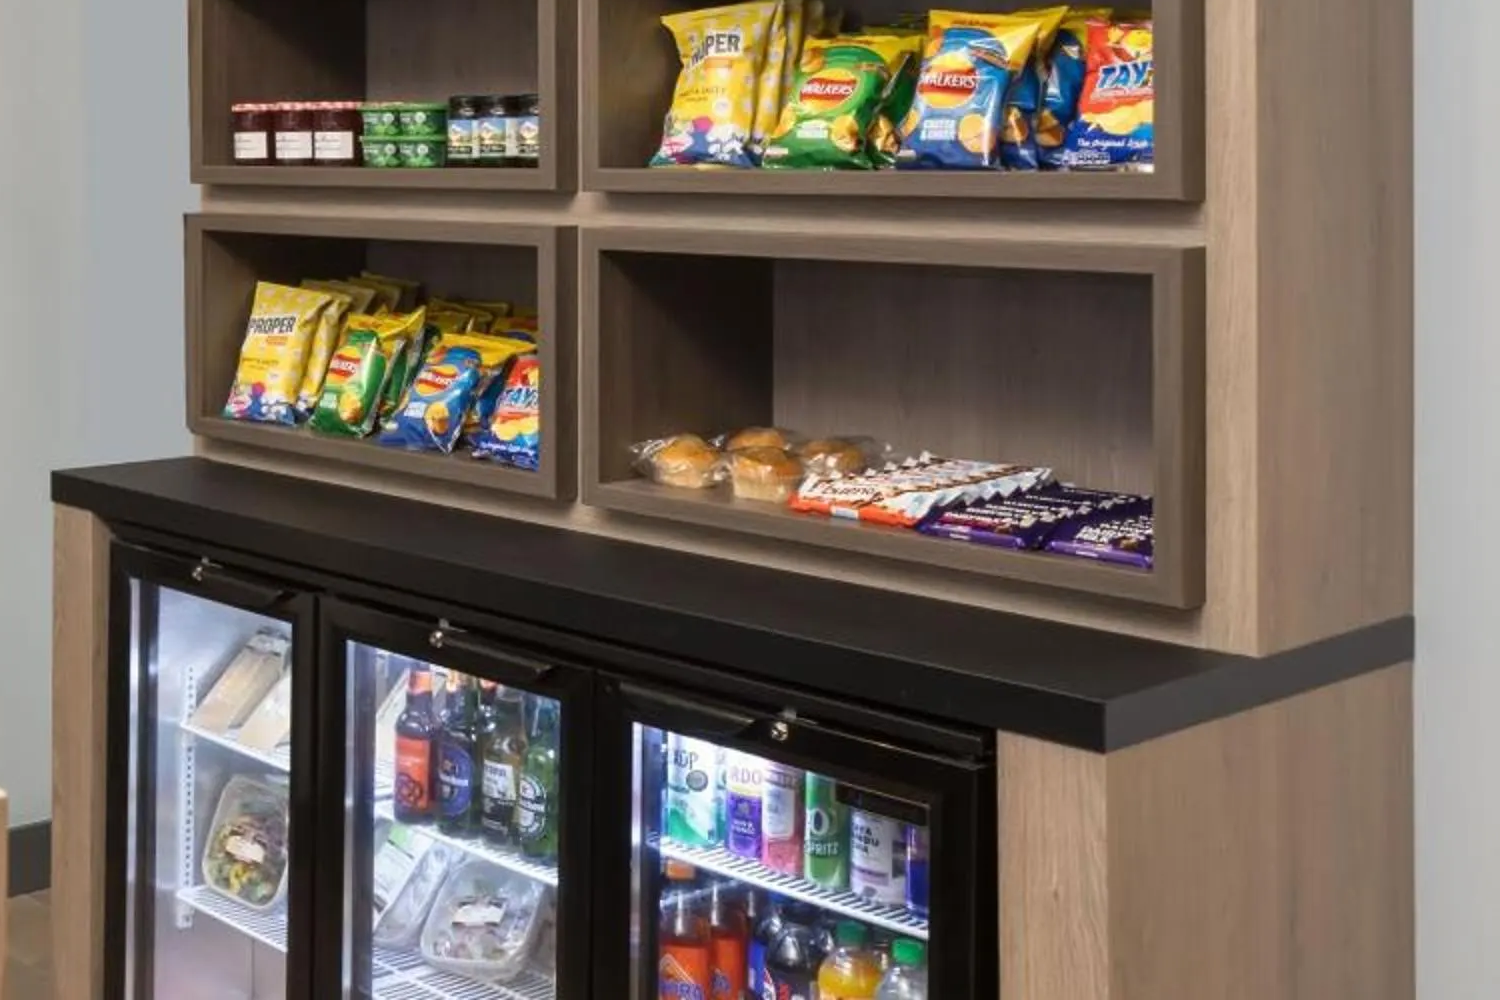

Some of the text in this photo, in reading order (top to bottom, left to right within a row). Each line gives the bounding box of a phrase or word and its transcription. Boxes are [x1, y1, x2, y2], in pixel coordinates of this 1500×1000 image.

[918, 73, 977, 89] WALKERS
[801, 82, 854, 97] WALKERS
[249, 315, 296, 334] PROPER
